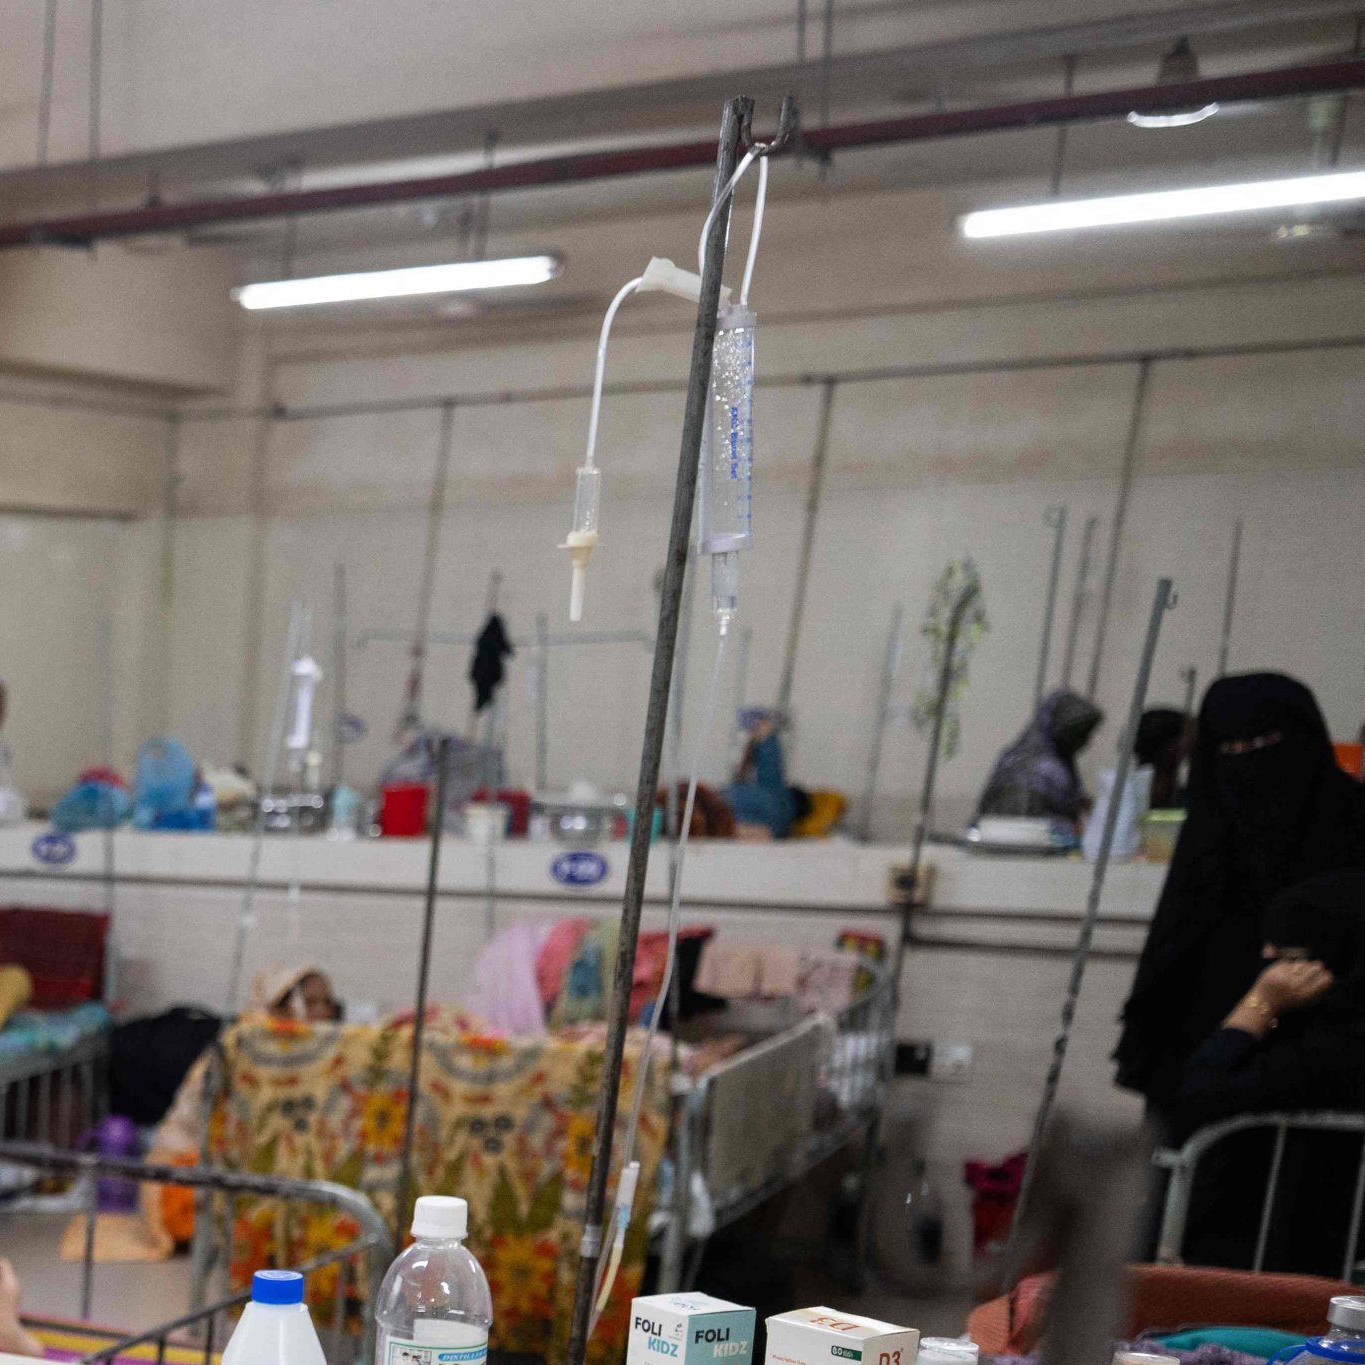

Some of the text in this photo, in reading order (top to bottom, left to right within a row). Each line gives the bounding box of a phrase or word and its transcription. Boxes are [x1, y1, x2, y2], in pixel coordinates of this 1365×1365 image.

[635, 1317, 662, 1336] FOLI
[695, 1328, 730, 1344] FOLI
[648, 1337, 678, 1357] KIDZ
[713, 1341, 747, 1358] KIDZ
